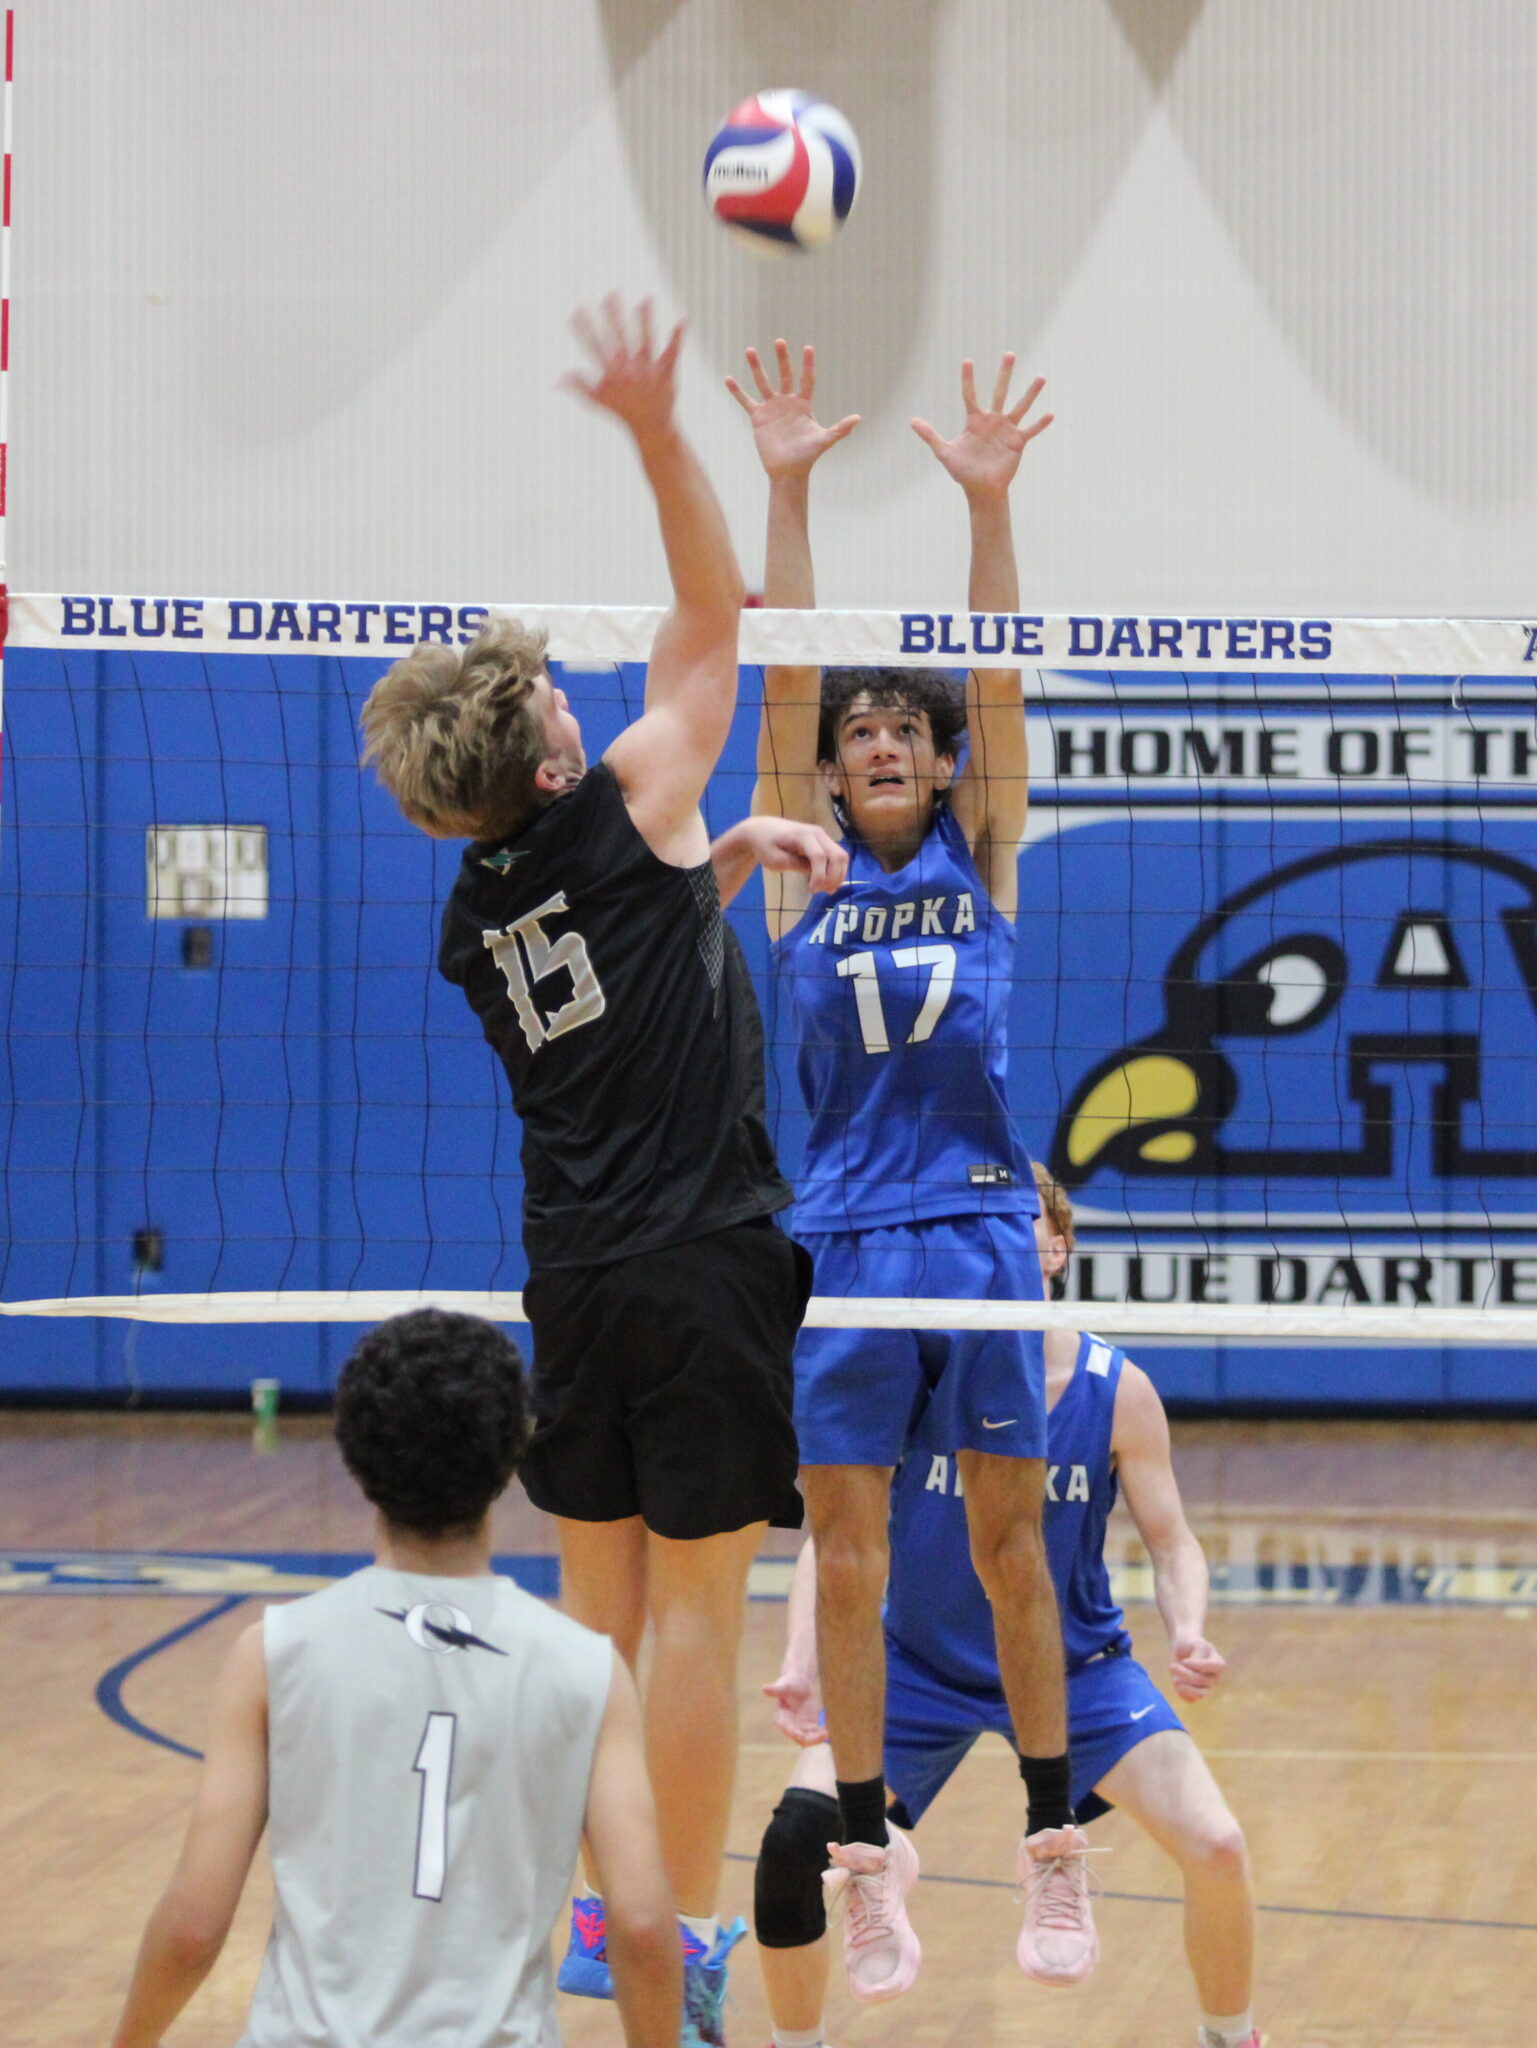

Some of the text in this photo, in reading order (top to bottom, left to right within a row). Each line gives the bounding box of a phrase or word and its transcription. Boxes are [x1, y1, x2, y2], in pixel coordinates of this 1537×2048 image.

[61, 596, 489, 645] BLUE DARTERS
[900, 614, 1332, 660] BLUE DARTERS
[1056, 728, 1298, 776] HOME
[1326, 728, 1433, 776] OF
[808, 892, 976, 945] APOPKA
[482, 890, 605, 1054] 15
[835, 944, 957, 1054] 17
[412, 1710, 457, 1903] 1
